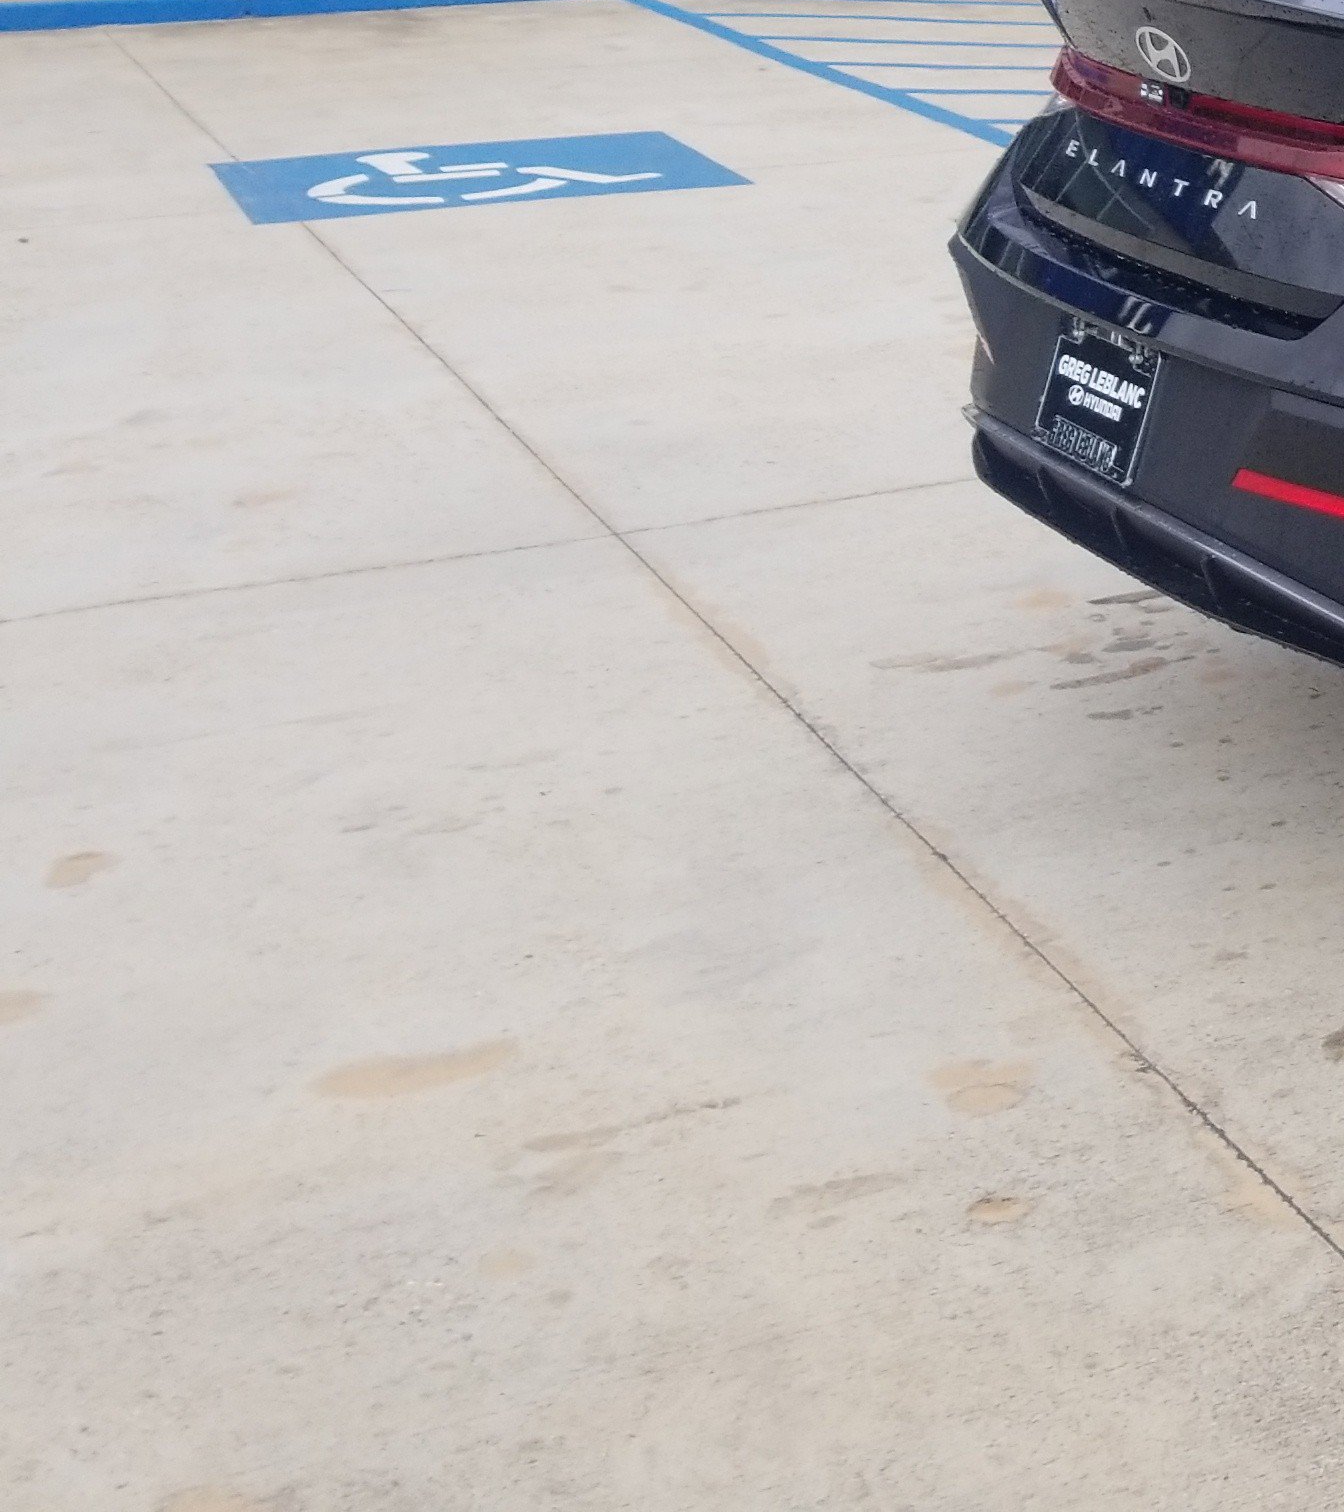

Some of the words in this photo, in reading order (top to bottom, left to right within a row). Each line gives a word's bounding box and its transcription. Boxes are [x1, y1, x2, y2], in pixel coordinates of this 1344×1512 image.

[1065, 139, 1257, 220] ELANTRA
[1058, 354, 1092, 385] GREG
[1088, 367, 1146, 409] LEBLANC
[1082, 392, 1123, 422] HYUNDAI
